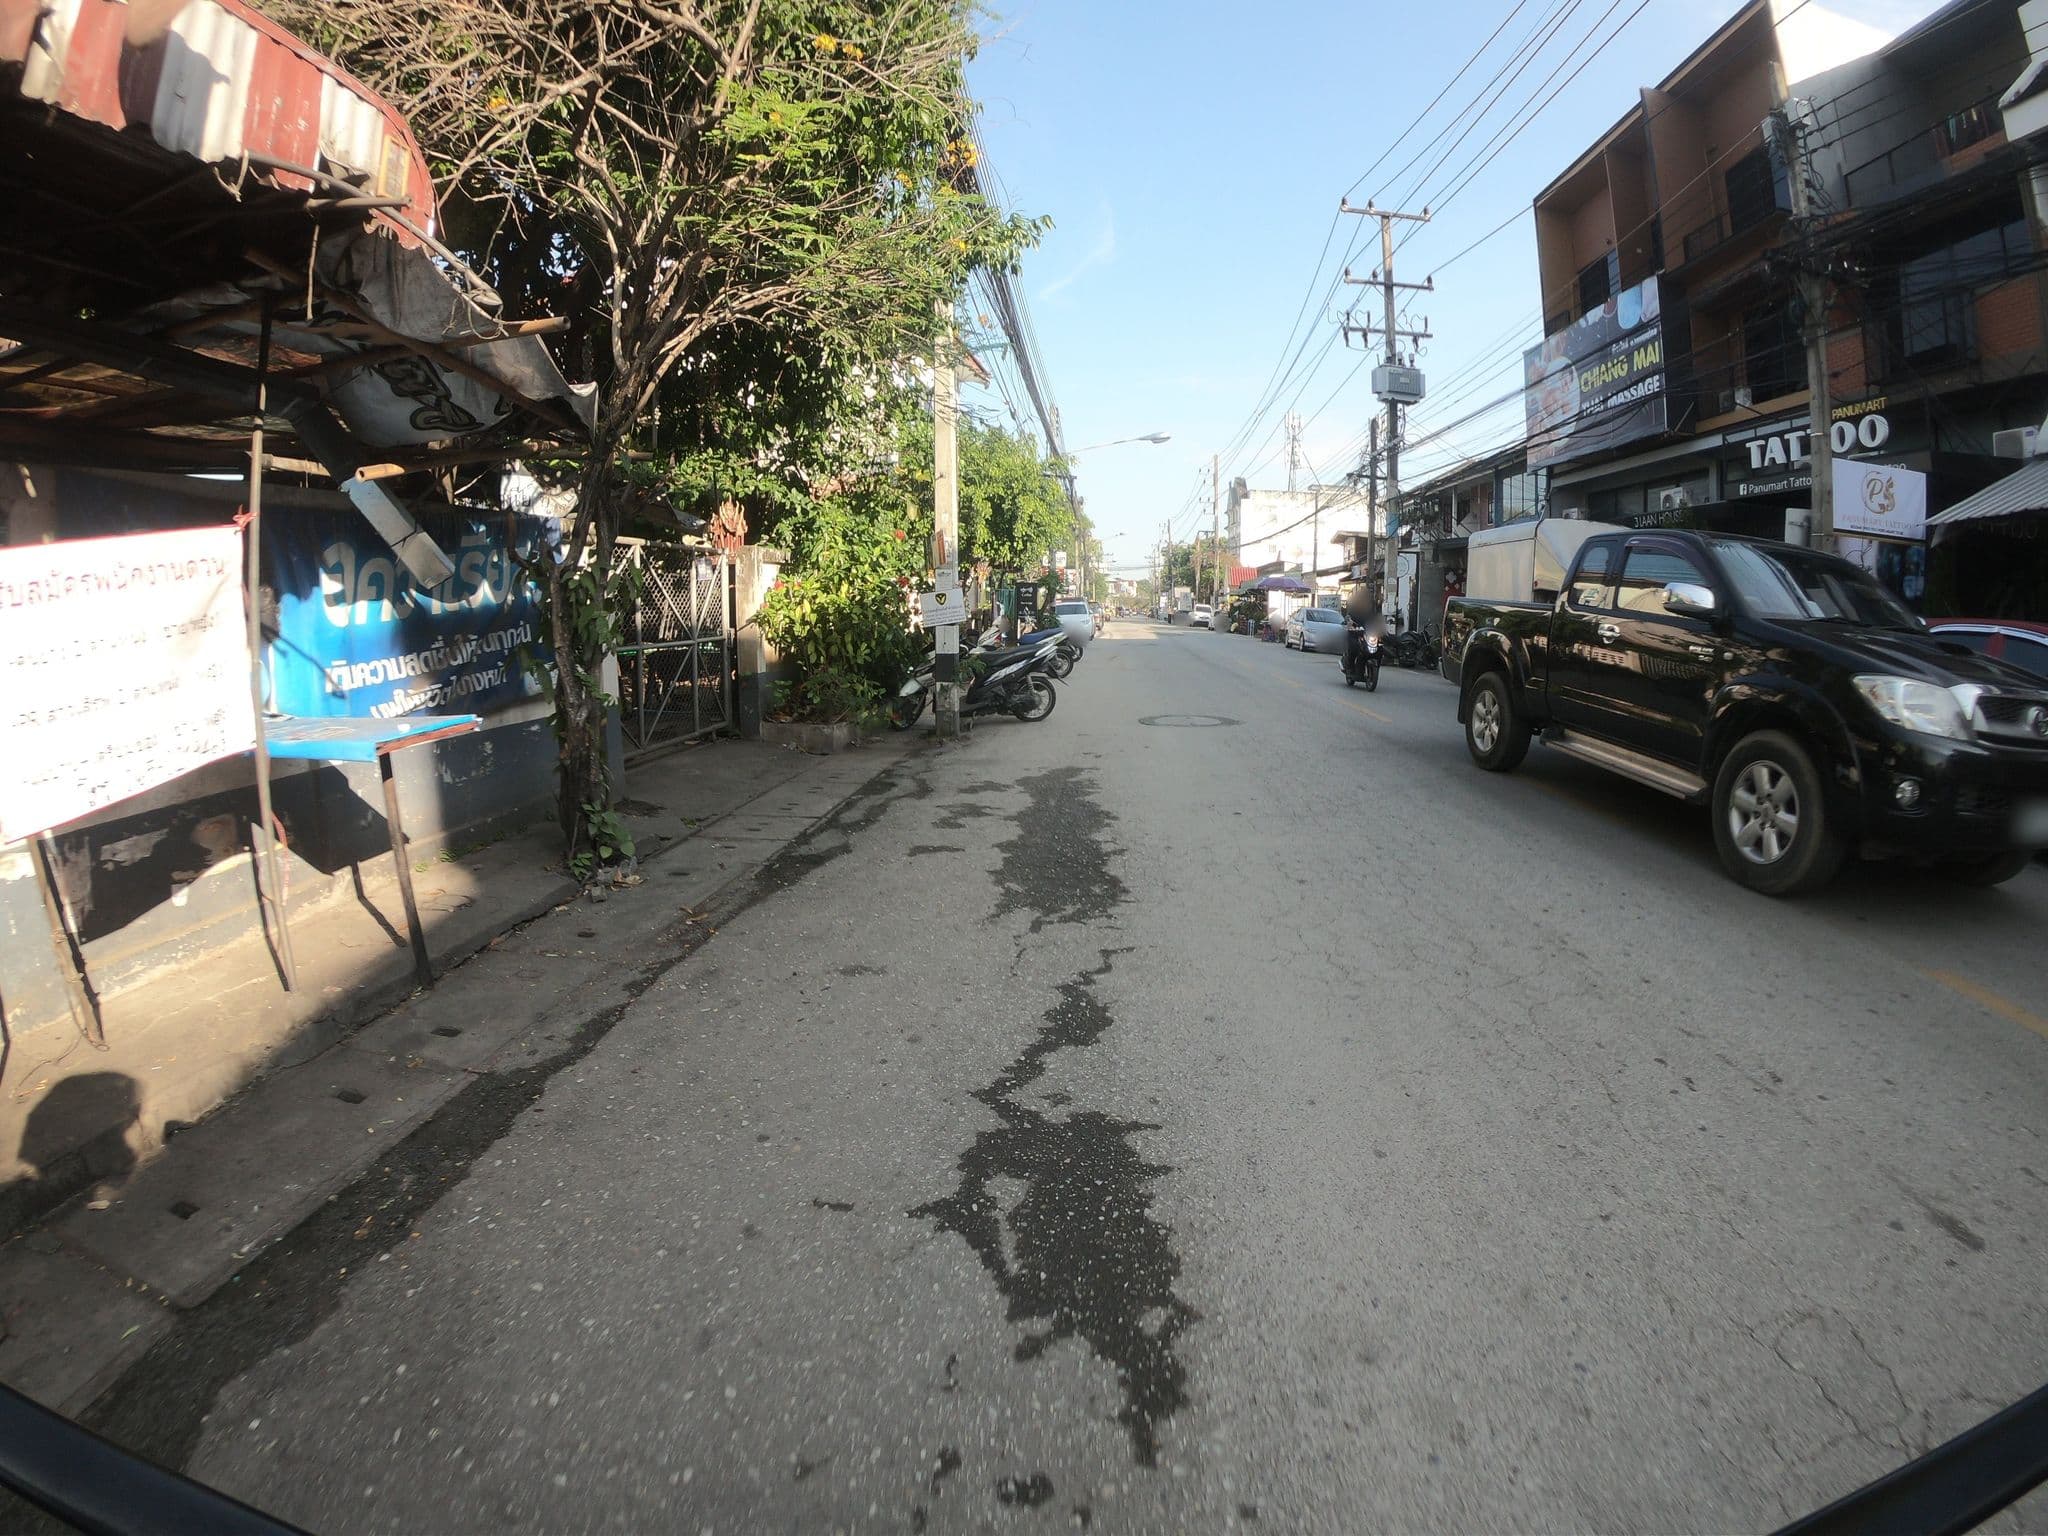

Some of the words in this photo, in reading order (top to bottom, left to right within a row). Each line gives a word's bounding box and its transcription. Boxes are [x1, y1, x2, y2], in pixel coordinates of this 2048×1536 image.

[1580, 354, 1628, 393] CHIANG
[1633, 341, 1660, 372] MAI
[1607, 374, 1660, 408] MASSAGE
[1831, 396, 1888, 420] PANUMART
[1745, 414, 1890, 469] TATOO
[1748, 480, 1788, 494] Panumart
